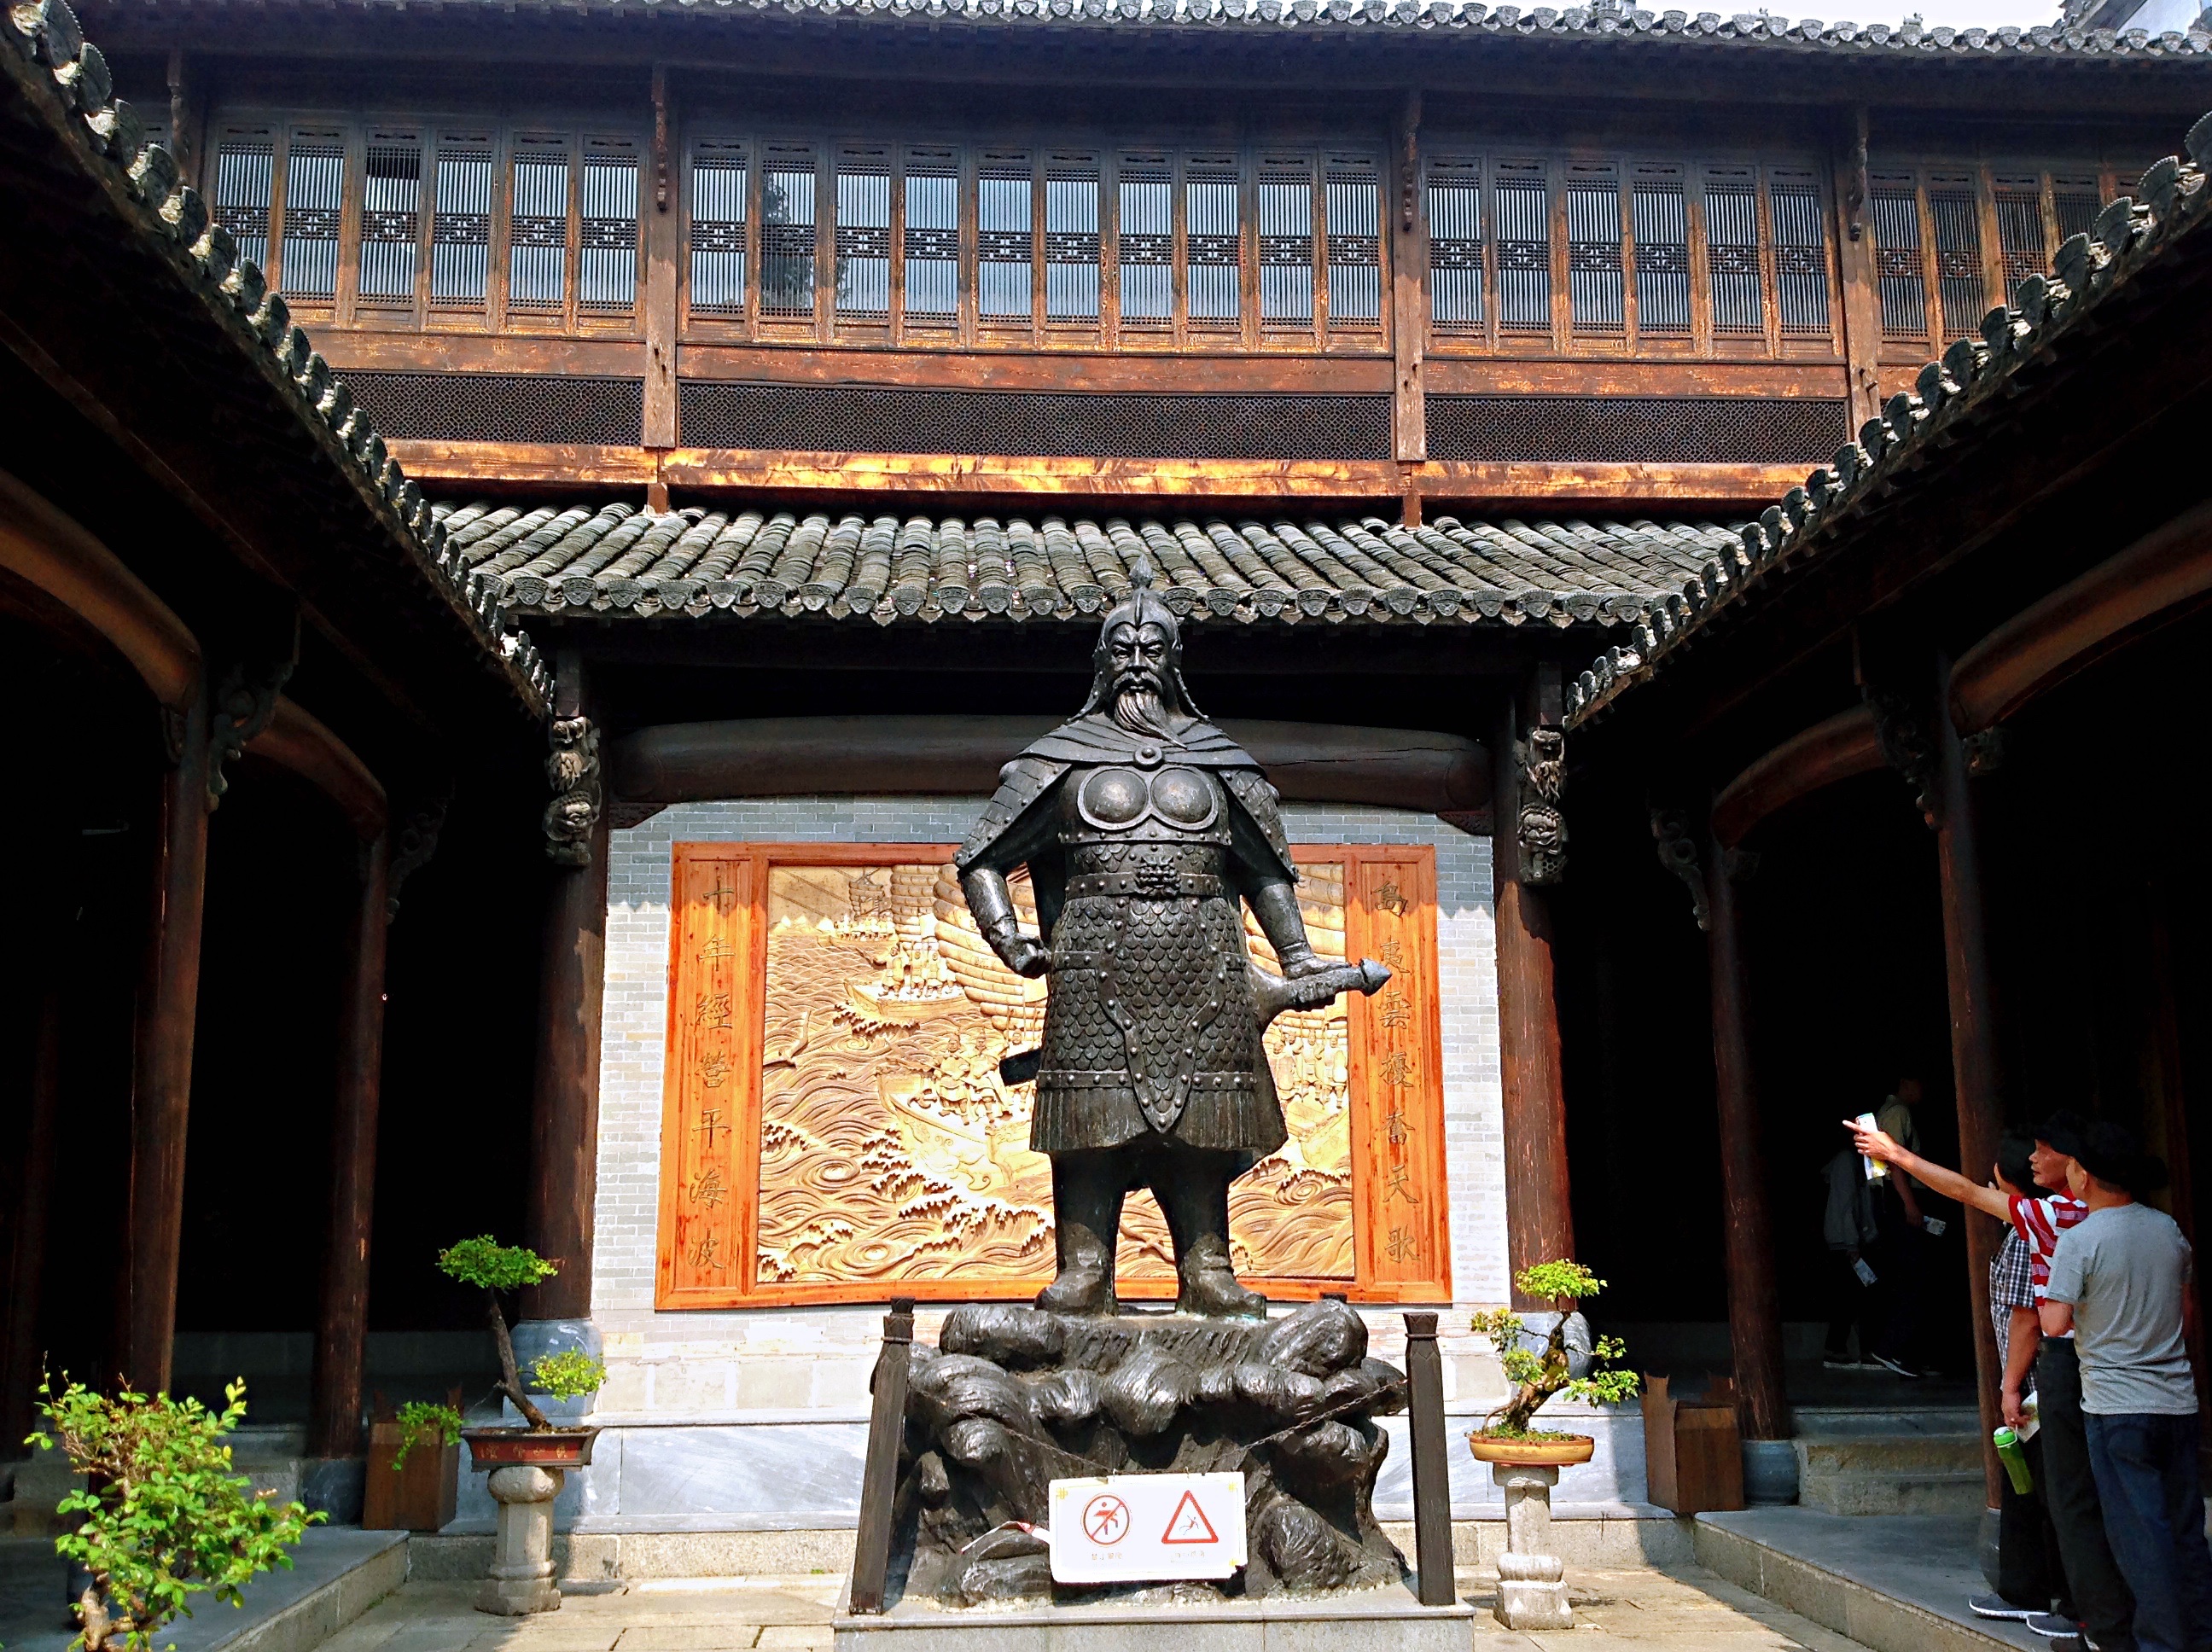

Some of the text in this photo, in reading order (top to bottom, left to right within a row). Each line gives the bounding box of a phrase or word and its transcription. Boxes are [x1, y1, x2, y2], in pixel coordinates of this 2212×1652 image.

[688, 875, 735, 1270] 十年經營平海波
